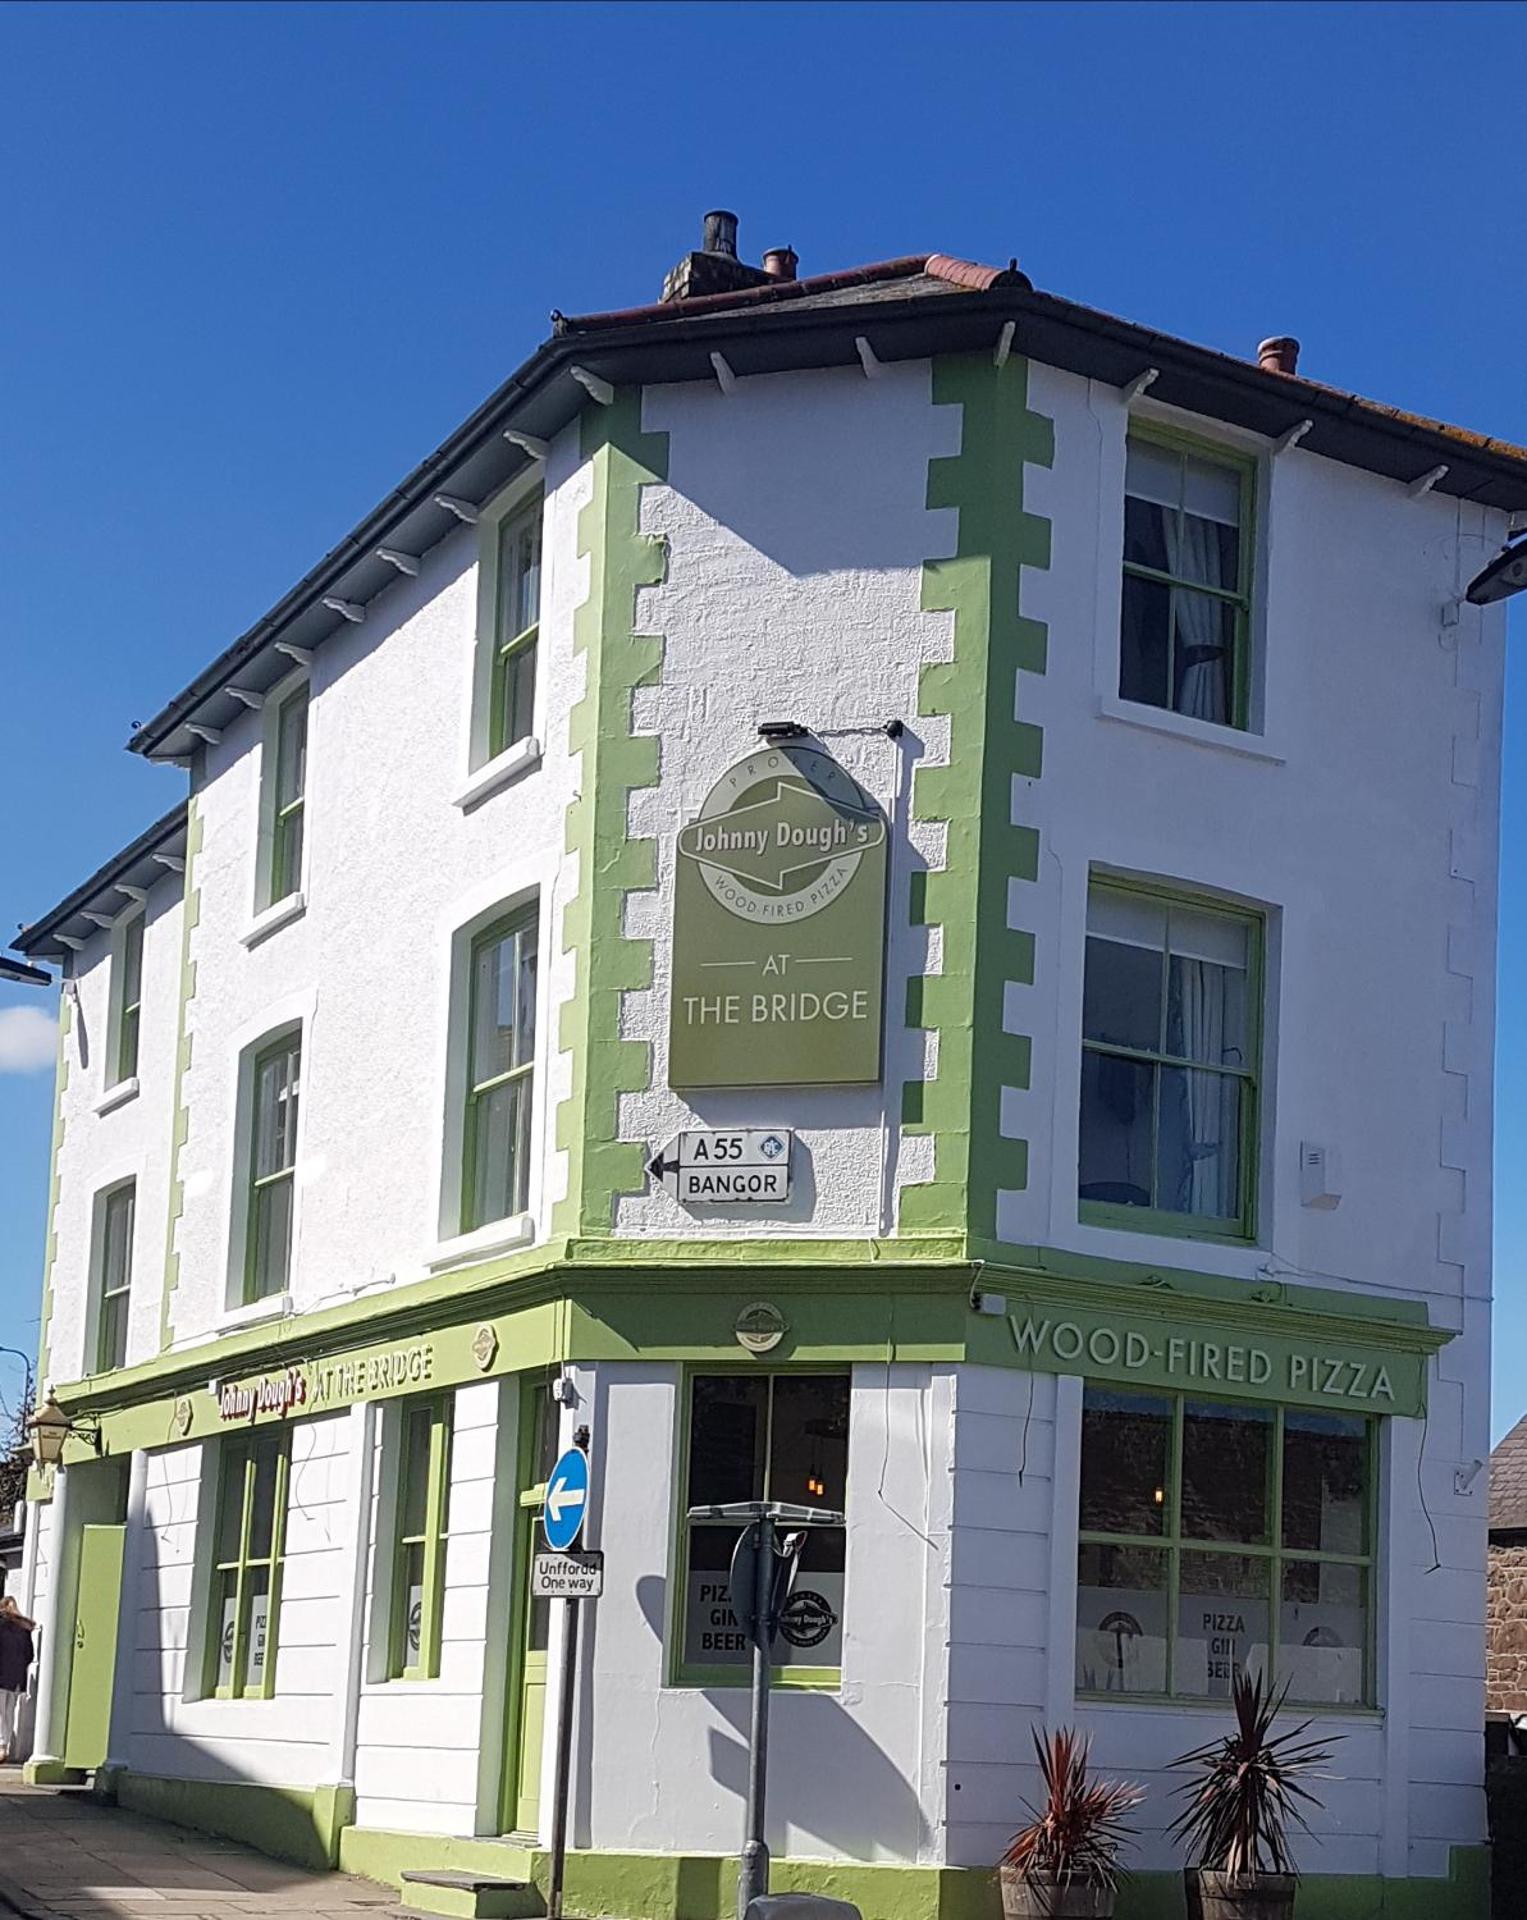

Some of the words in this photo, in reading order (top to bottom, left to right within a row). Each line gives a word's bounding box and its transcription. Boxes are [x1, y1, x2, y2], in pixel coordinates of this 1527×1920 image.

[696, 825, 769, 856] Johnny
[777, 818, 868, 851] Dough's
[715, 875, 757, 913] WOOD
[762, 900, 805, 917] FIRED
[810, 867, 848, 905] PIZZA
[762, 955, 791, 976] AT
[683, 996, 740, 1025] THE
[752, 991, 868, 1023] BRIDGE
[693, 1137, 743, 1161] A55
[688, 1174, 777, 1194] BANGOR
[1009, 1313, 1272, 1384] WOOD-FIRED
[1290, 1354, 1395, 1400] PIZZA
[218, 1382, 258, 1423] Johnny
[256, 1366, 308, 1417] Dough's
[336, 1360, 366, 1398] THE
[367, 1344, 434, 1391] BRIDGE
[539, 1561, 597, 1575] Unffordd
[541, 1576, 566, 1589] One
[567, 1579, 593, 1592] way
[700, 1585, 732, 1602] PIZ
[1203, 1613, 1245, 1632] PIZZA
[702, 1632, 746, 1650] BEER
